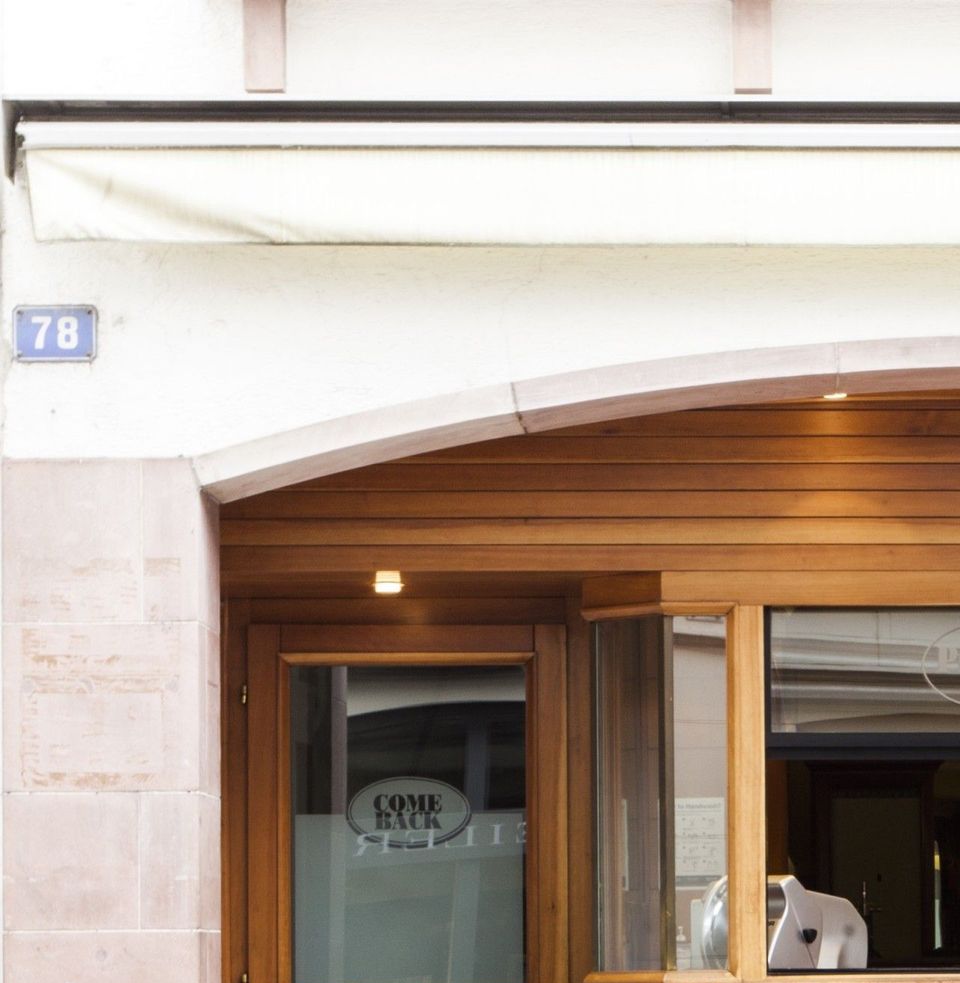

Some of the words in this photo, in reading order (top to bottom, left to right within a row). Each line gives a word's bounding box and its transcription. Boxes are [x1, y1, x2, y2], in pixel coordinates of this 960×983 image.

[31, 315, 79, 350] 78
[373, 794, 442, 813] COME
[375, 812, 442, 830] BACK
